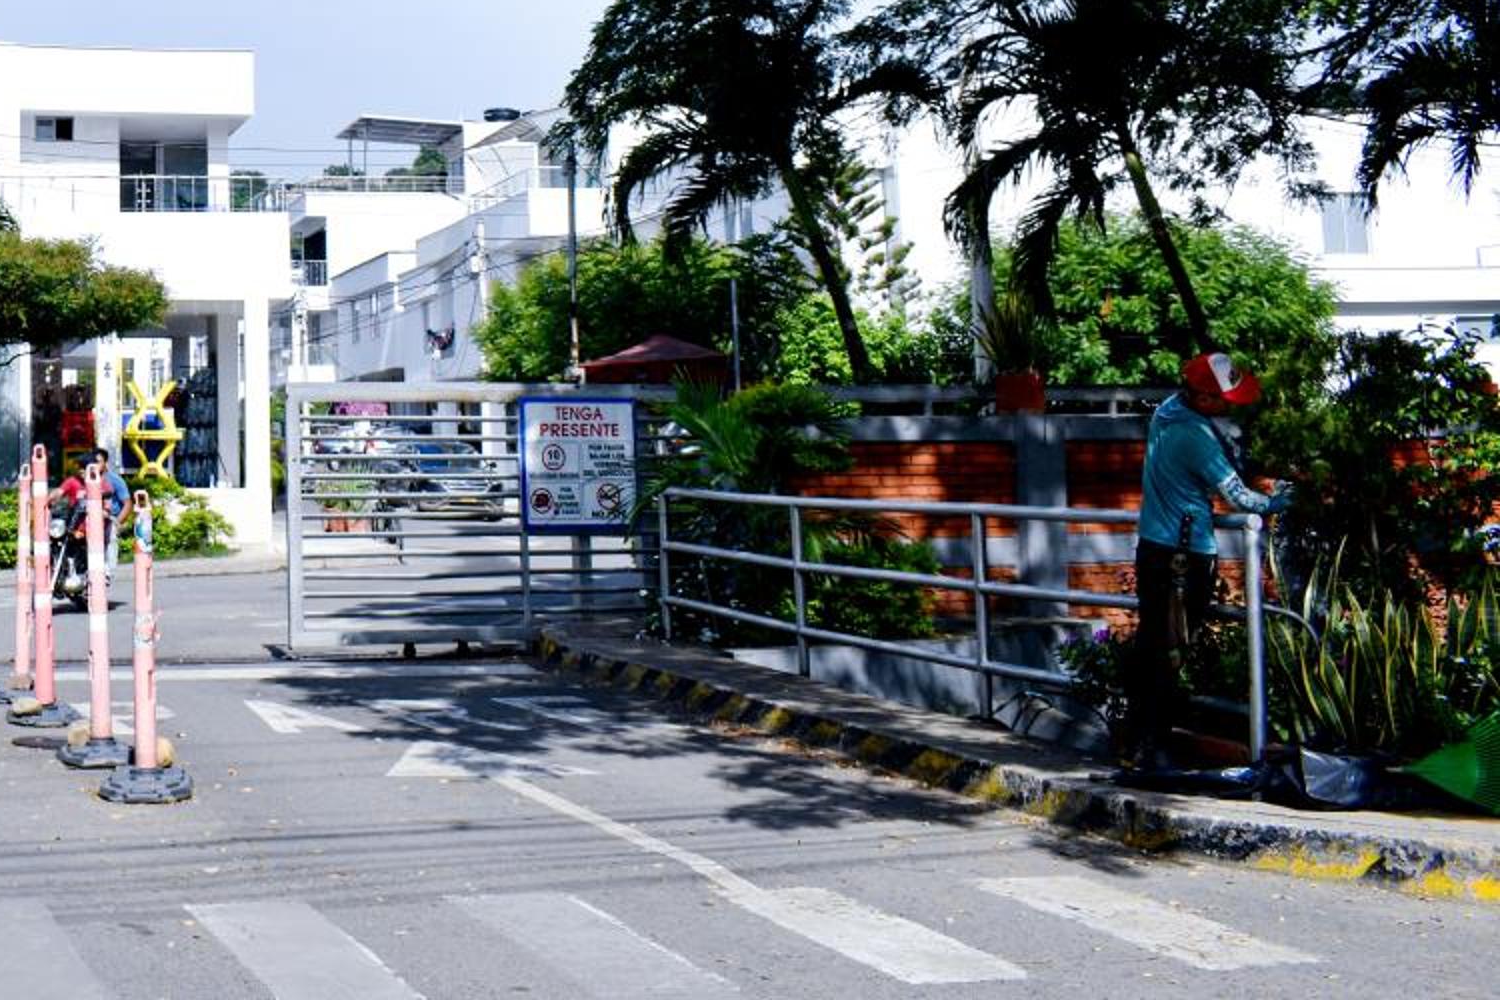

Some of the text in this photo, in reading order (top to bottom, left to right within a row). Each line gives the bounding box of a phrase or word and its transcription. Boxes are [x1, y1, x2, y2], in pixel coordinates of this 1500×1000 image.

[555, 407, 604, 421] TENGA
[539, 423, 620, 437] PRESENTE
[547, 449, 561, 460] 10
